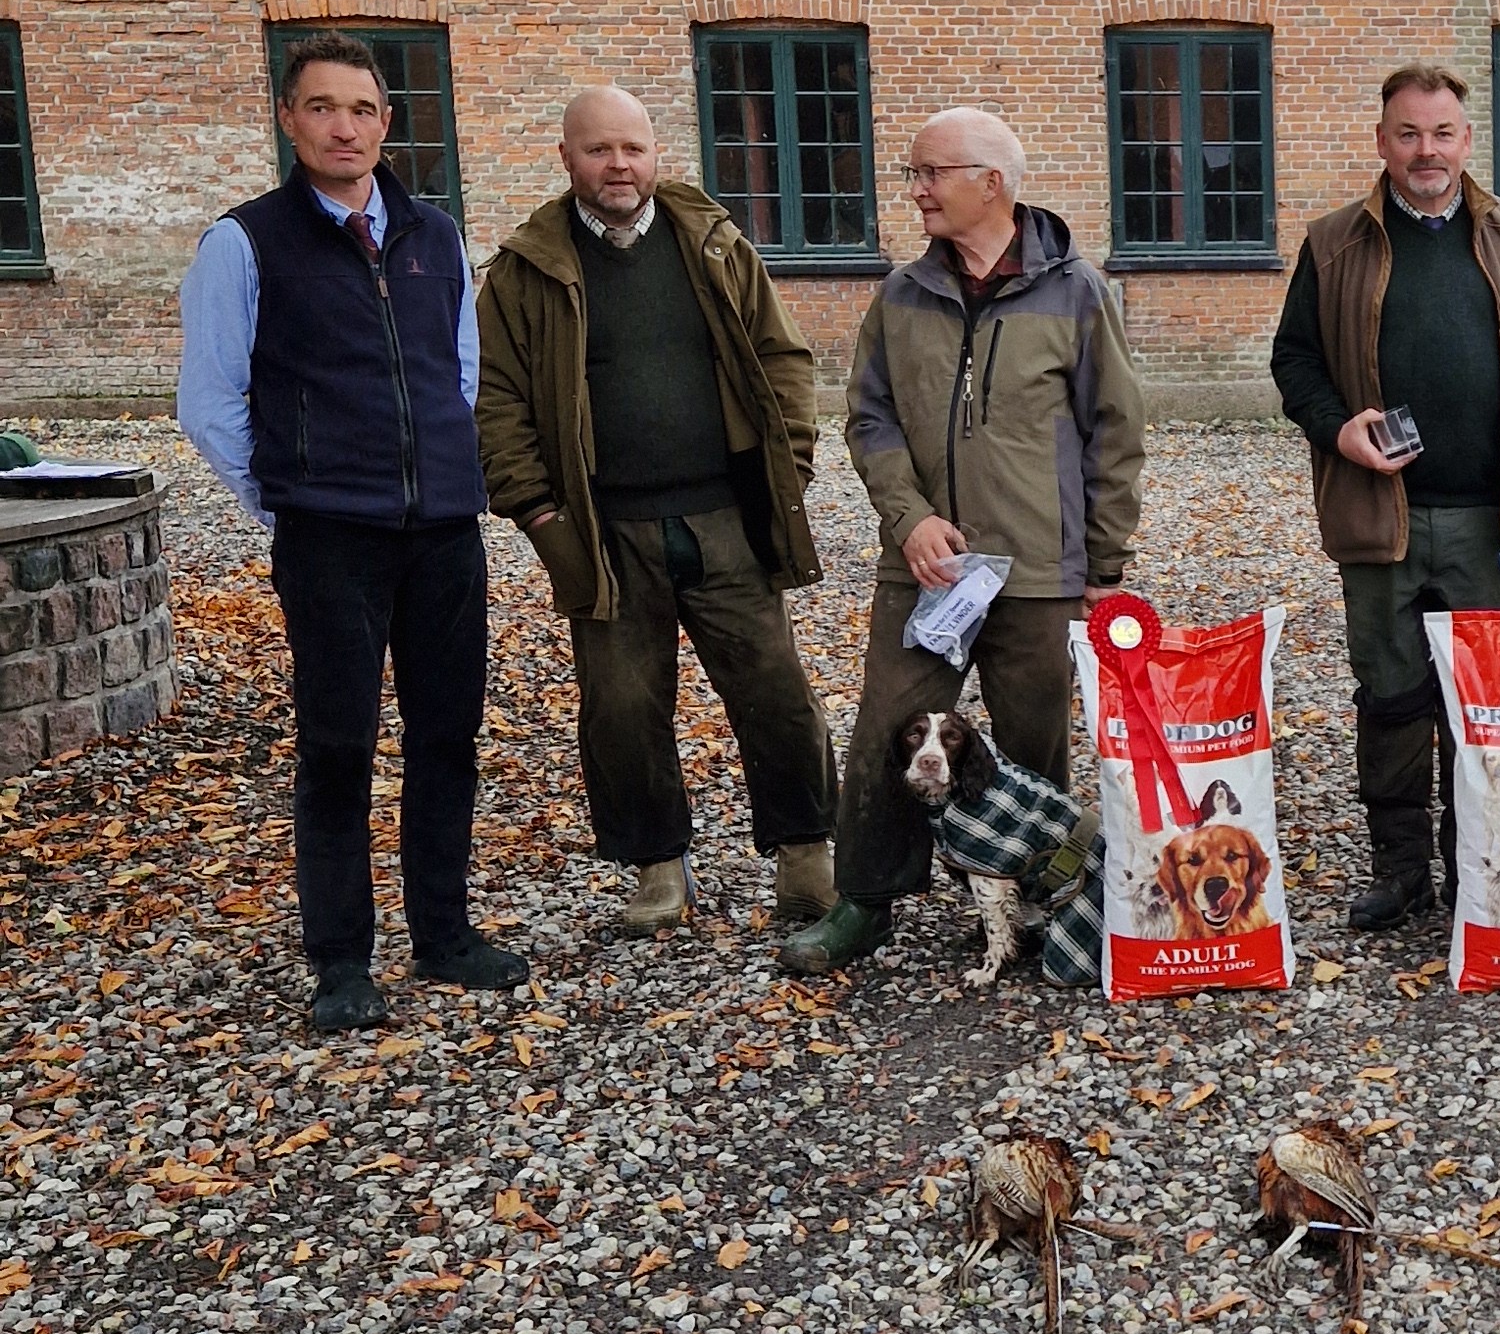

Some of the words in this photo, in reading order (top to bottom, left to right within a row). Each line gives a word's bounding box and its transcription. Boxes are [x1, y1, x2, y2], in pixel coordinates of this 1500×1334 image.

[1207, 742, 1227, 752] PET
[1229, 734, 1254, 748] FOOD
[1153, 943, 1241, 965] ADULT
[1139, 966, 1168, 975] THE
[1169, 964, 1222, 976] FAMILY
[1224, 959, 1256, 971] DOG
